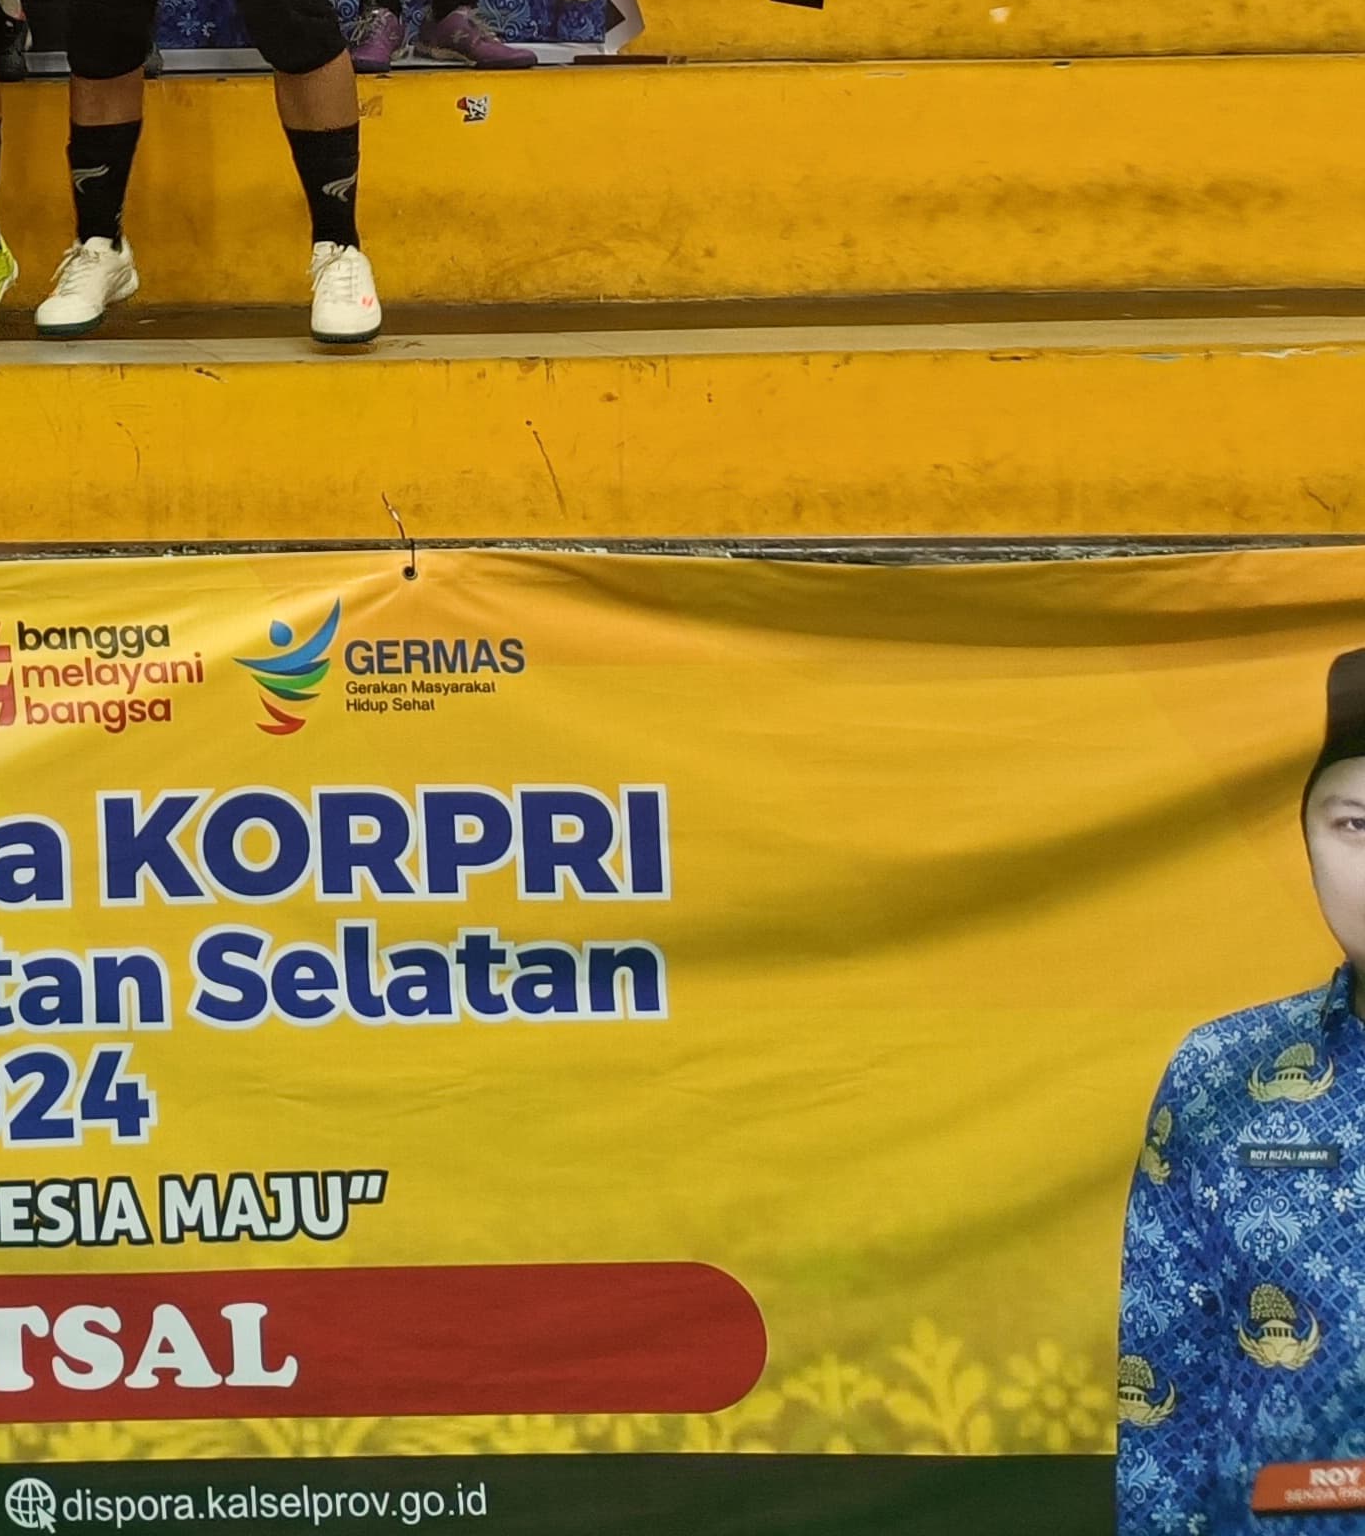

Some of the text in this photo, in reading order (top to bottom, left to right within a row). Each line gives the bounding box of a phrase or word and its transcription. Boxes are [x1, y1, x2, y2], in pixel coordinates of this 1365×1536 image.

[17, 621, 170, 658] bangga
[345, 638, 525, 675] GERMAS
[21, 652, 203, 693] melayani
[345, 679, 497, 696] Gerakan Masyarakat
[25, 695, 173, 734] bangsa
[345, 696, 436, 713] Hidup Sehat
[105, 791, 665, 902] KORPRI
[191, 925, 661, 1022] Selatan
[1250, 1150, 1328, 1160] ROY RIZALI ANWAR
[1310, 1467, 1359, 1486] ROY
[60, 1482, 488, 1524] dispora.kalselprov.go.id
